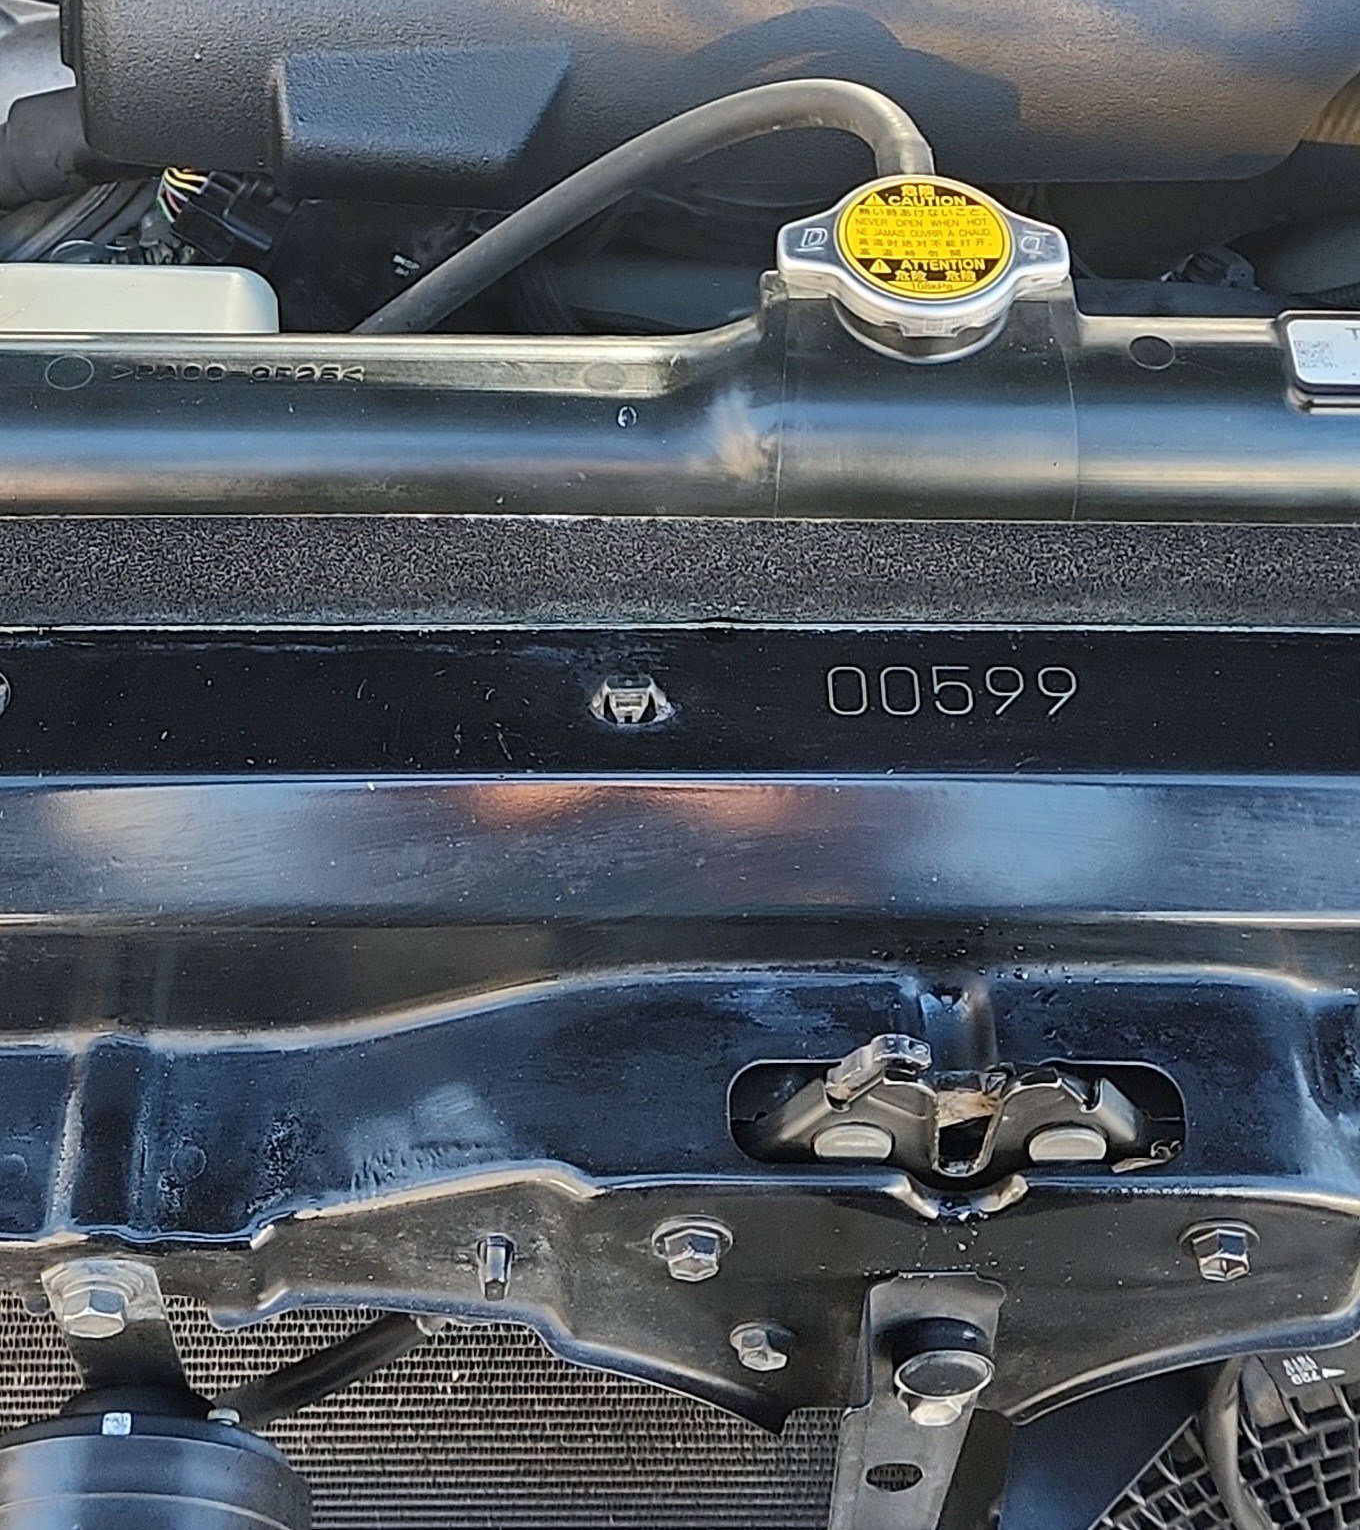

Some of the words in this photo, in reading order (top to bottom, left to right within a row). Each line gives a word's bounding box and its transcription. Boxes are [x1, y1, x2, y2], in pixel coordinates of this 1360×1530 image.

[888, 194, 967, 207] CAUTION
[855, 217, 889, 227] NEVER
[895, 218, 924, 228] OPEN
[930, 218, 960, 228] WHEN
[899, 258, 986, 271] ATTENTION
[827, 665, 1077, 716] 00599
